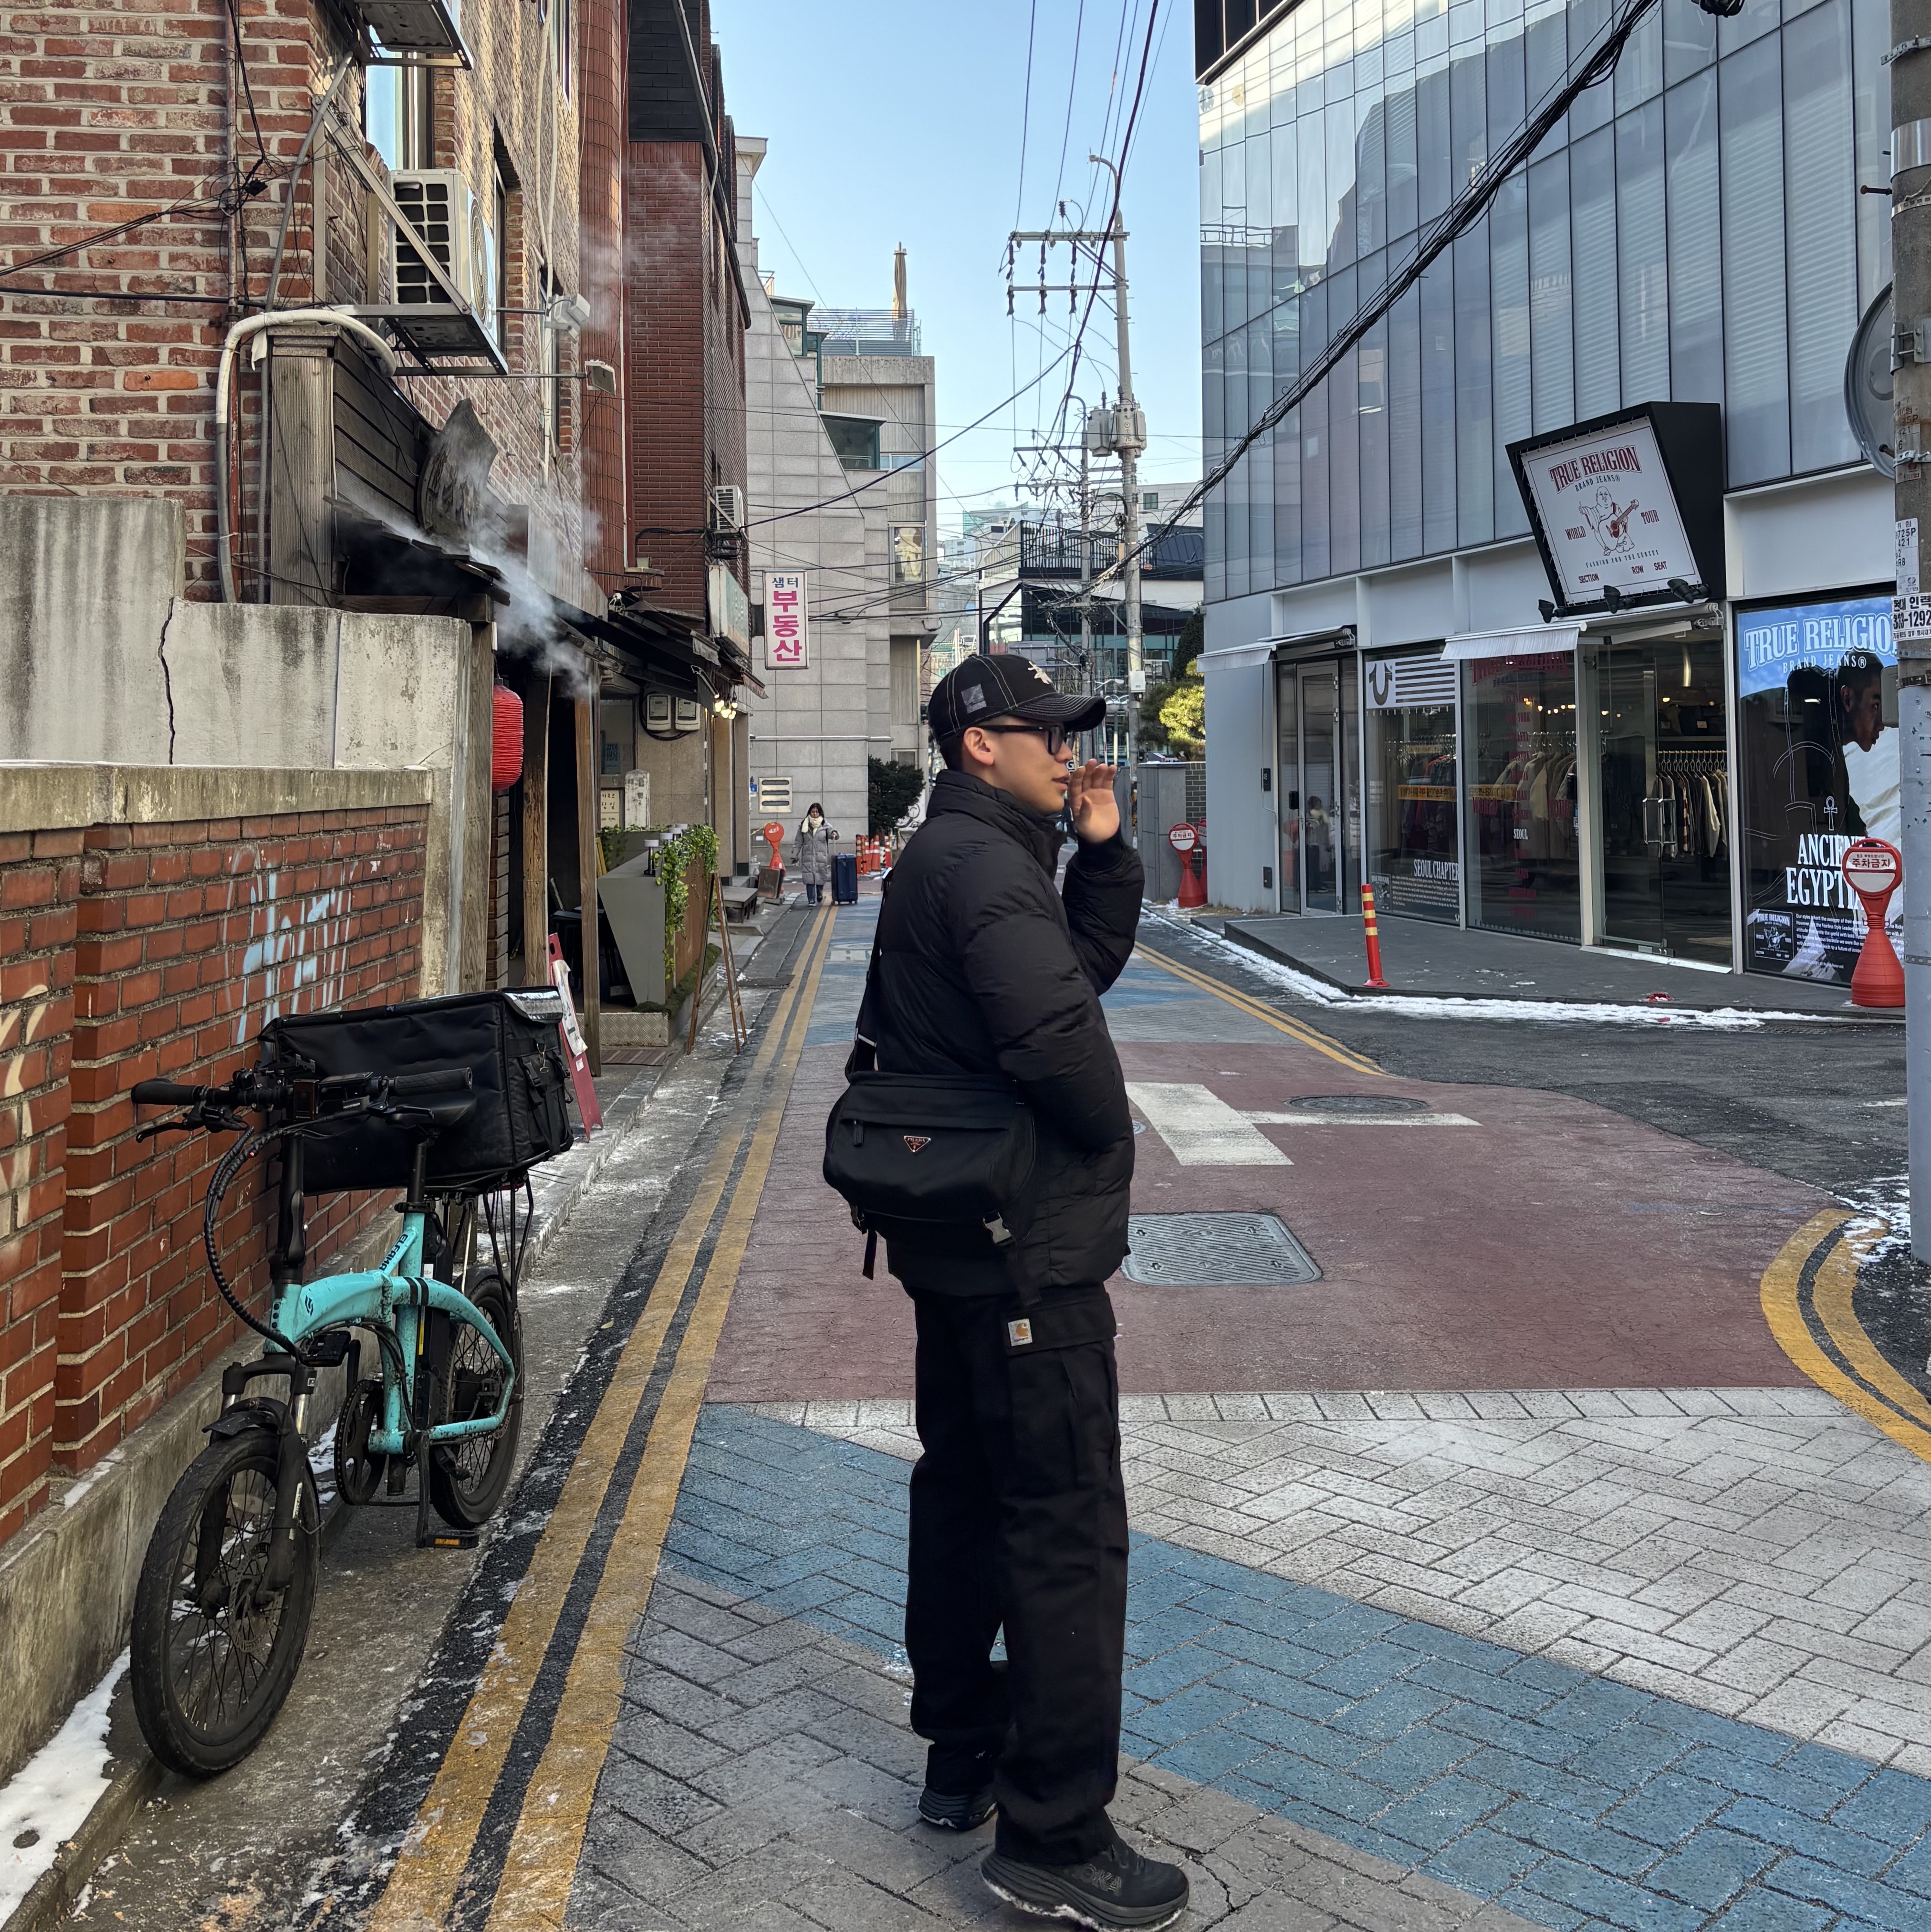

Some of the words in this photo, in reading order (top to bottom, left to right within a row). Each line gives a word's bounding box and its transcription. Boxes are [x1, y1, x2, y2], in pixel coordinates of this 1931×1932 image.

[1549, 460, 1581, 493] TRUE
[1580, 445, 1641, 476] RELIGION
[1575, 479, 1594, 492] BRAND
[1565, 526, 1586, 540] WORLD
[1640, 510, 1660, 524] TOUR
[772, 577, 798, 588] 샘터
[1578, 573, 1599, 584] SECTION
[1631, 565, 1644, 574] ROW
[1654, 561, 1667, 571] SEAT
[772, 590, 802, 662] 부동산
[1744, 622, 1798, 671] TRUE
[1804, 614, 1896, 654] RELIGIO
[1783, 656, 1816, 674] BRAND
[1513, 829, 1528, 840] SEOUL
[1797, 834, 1866, 867] ANCIE
[1414, 859, 1432, 878] SEOUL
[1433, 861, 1459, 881] CHAPTER
[1852, 858, 1890, 868] 주차금지
[1786, 867, 1863, 910] EGYPTI
